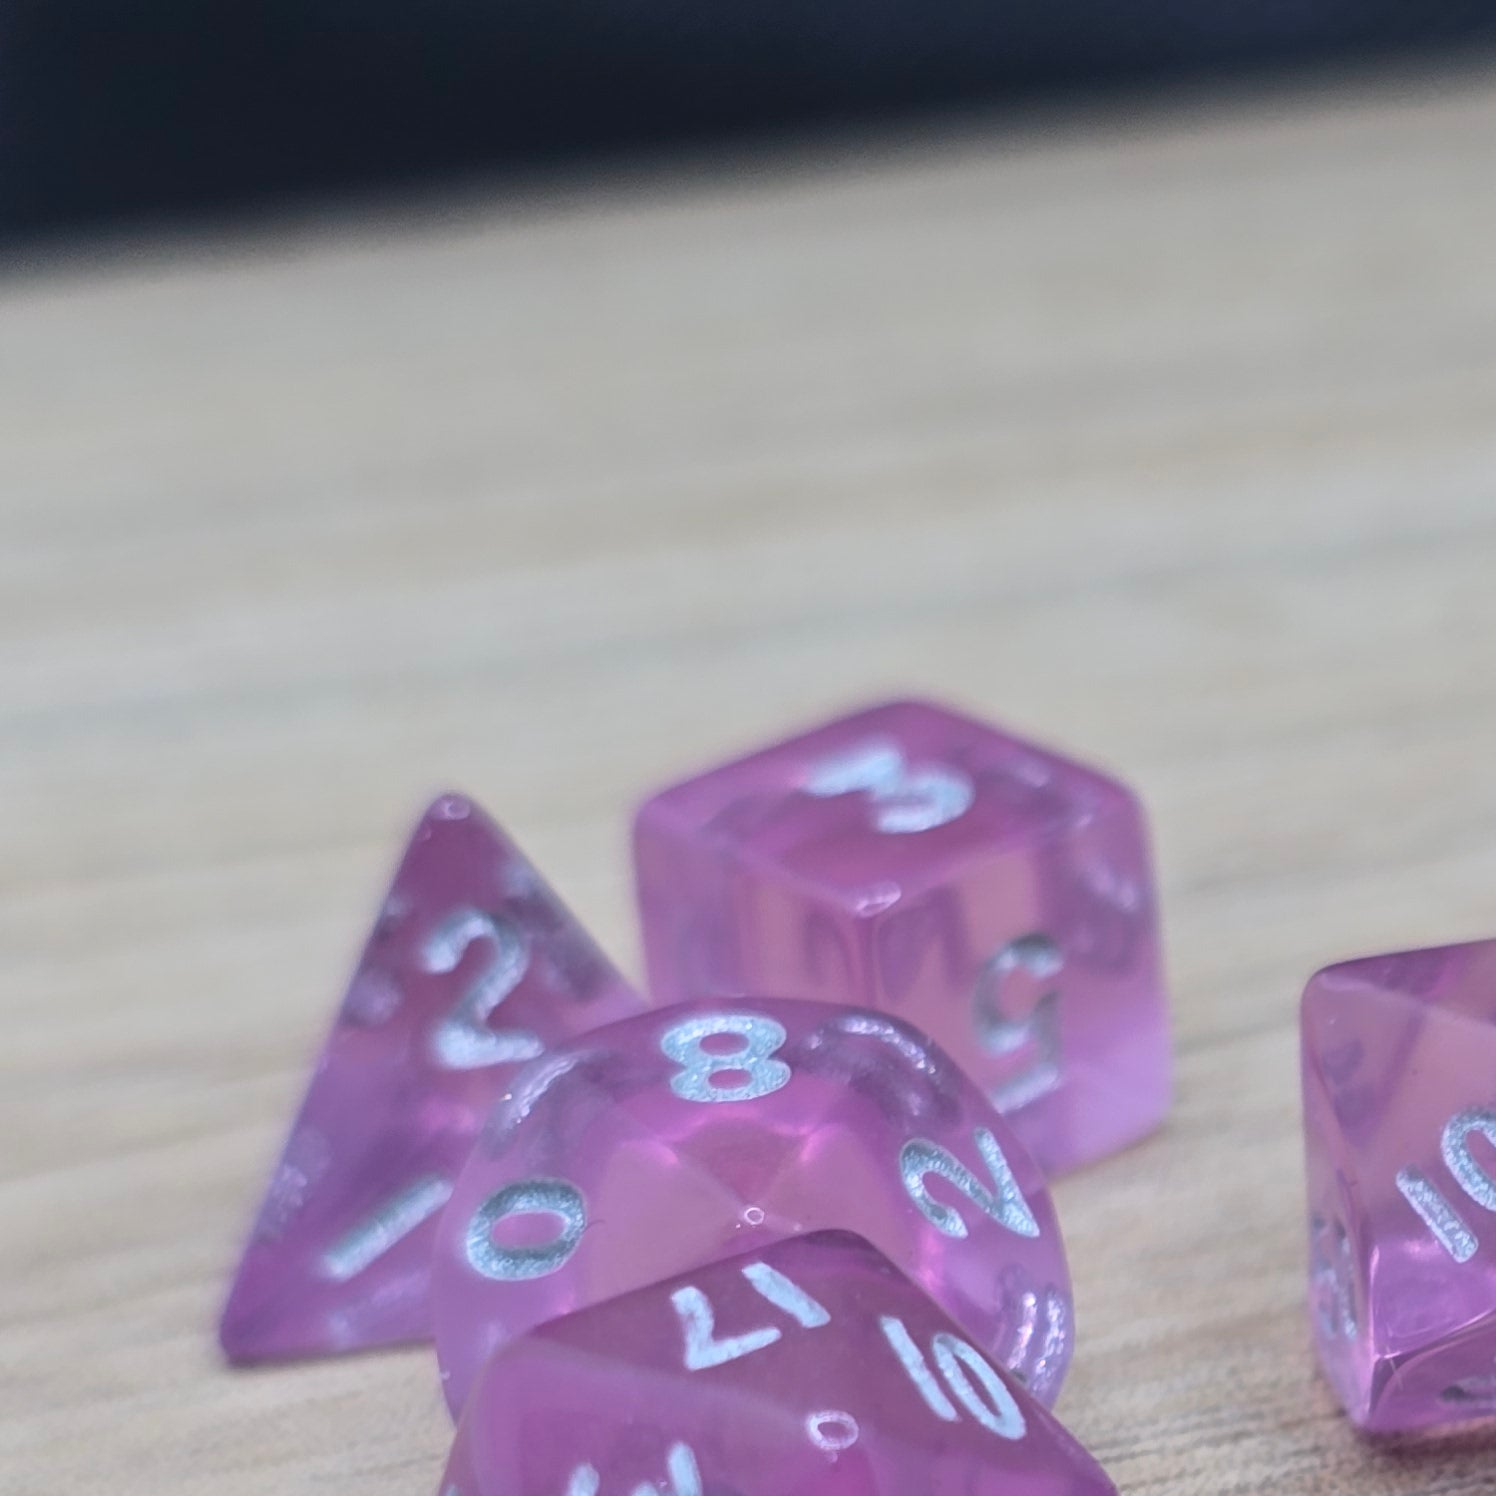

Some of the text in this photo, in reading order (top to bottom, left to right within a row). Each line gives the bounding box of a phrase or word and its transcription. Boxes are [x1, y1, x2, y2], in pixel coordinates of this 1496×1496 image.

[803, 733, 975, 834] 3
[420, 910, 545, 1070] 2
[660, 1014, 792, 1103] 8
[898, 1127, 1041, 1238] 2
[671, 1261, 832, 1371] 17
[879, 1316, 1027, 1441] 10
